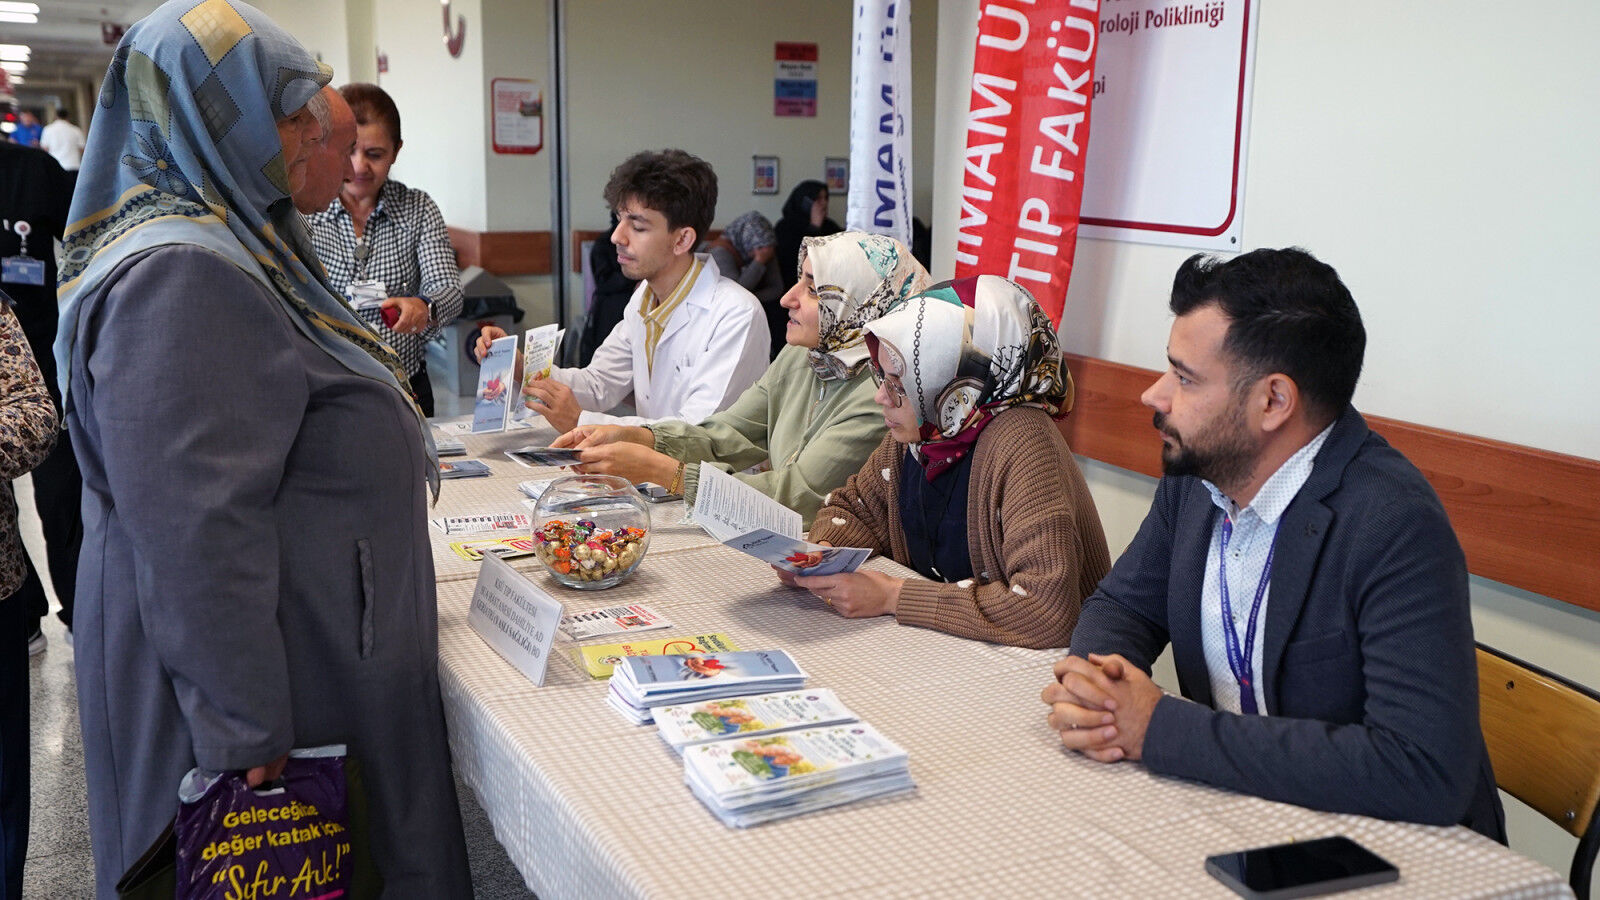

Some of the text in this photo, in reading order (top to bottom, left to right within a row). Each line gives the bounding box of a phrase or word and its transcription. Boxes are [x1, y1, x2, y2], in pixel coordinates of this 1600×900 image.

[1100, 1, 1225, 35] roloji Polikliniği
[1091, 75, 1106, 99] pi
[1007, 197, 1063, 284] TIP
[201, 833, 263, 860] değer
